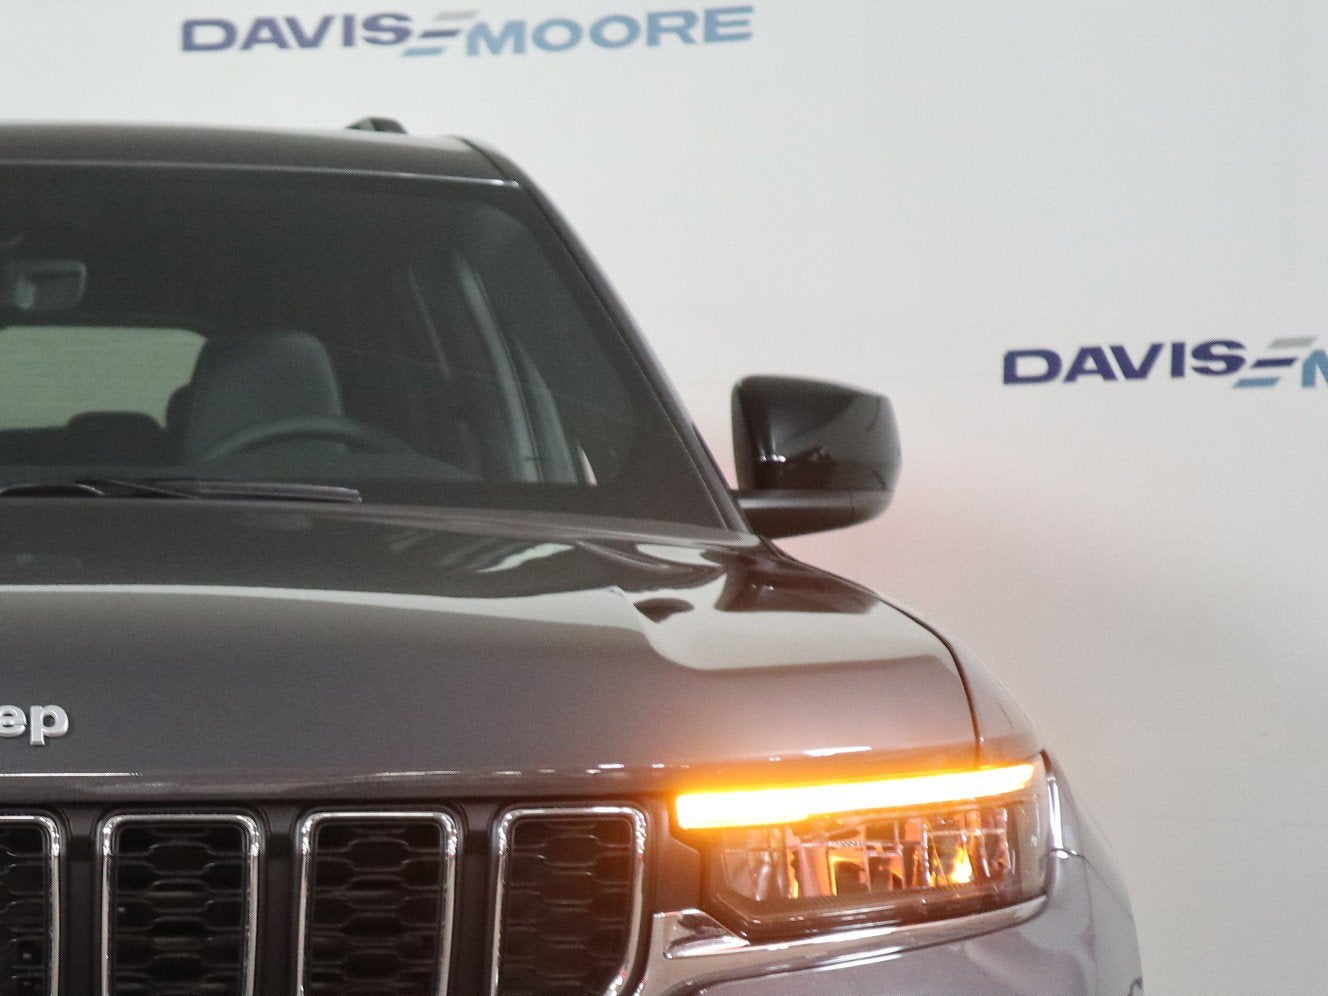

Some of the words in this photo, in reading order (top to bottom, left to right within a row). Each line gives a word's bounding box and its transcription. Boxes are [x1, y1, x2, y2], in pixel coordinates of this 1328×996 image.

[181, 13, 411, 52] DAVIS
[466, 6, 753, 56] MOORE
[1003, 339, 1247, 385] DAVIS
